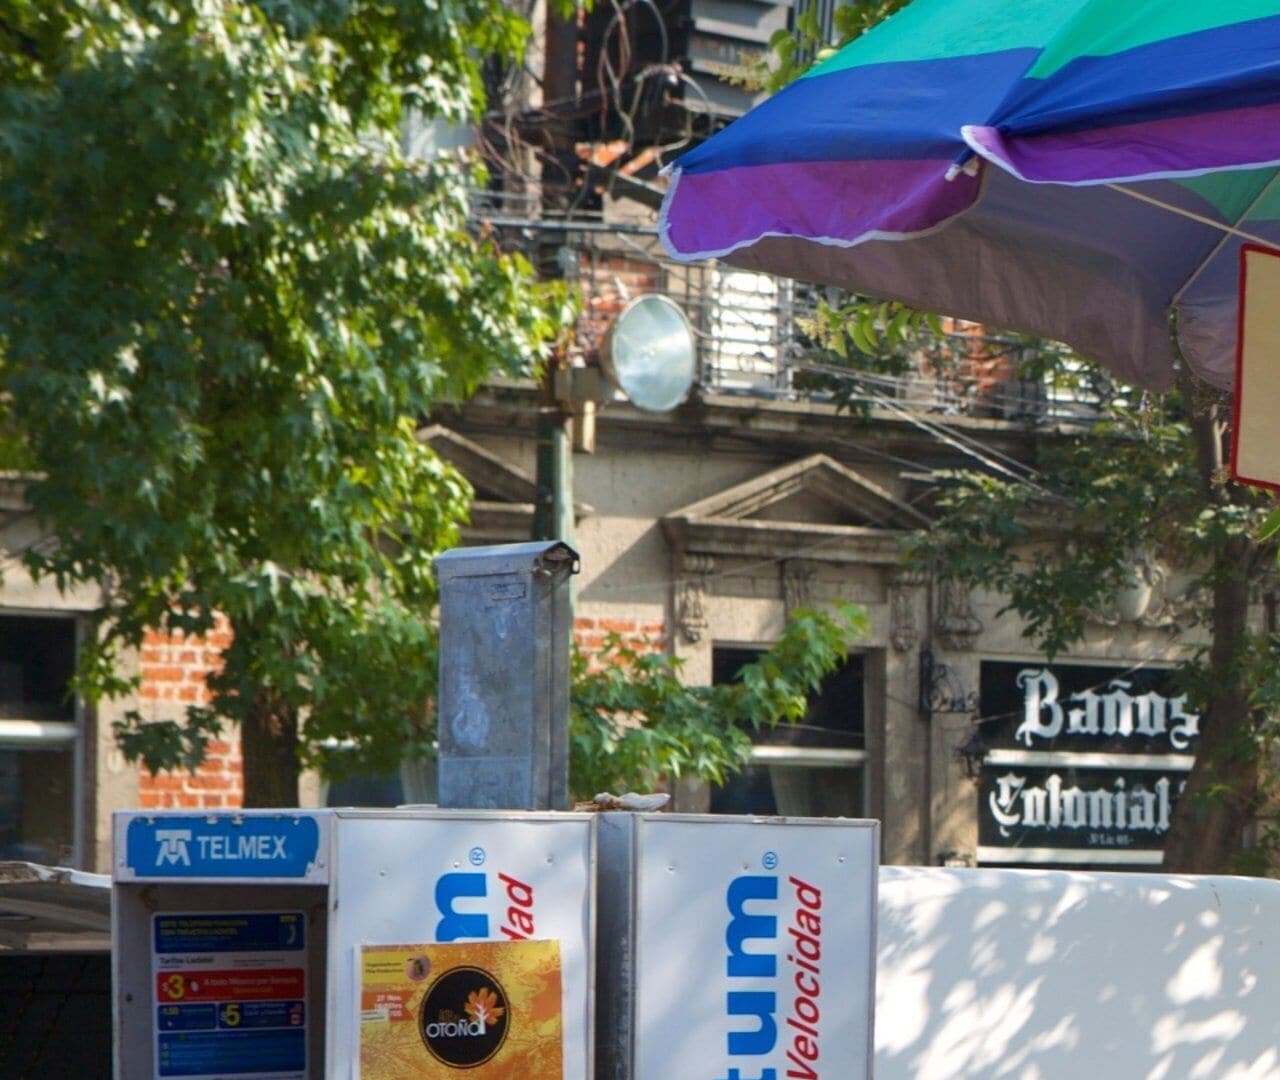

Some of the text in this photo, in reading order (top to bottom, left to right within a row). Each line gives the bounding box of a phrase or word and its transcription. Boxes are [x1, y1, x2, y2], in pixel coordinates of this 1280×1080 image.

[1015, 667, 1200, 750] Baños
[989, 772, 1171, 838] Colonial
[197, 835, 287, 860] TELMEX
